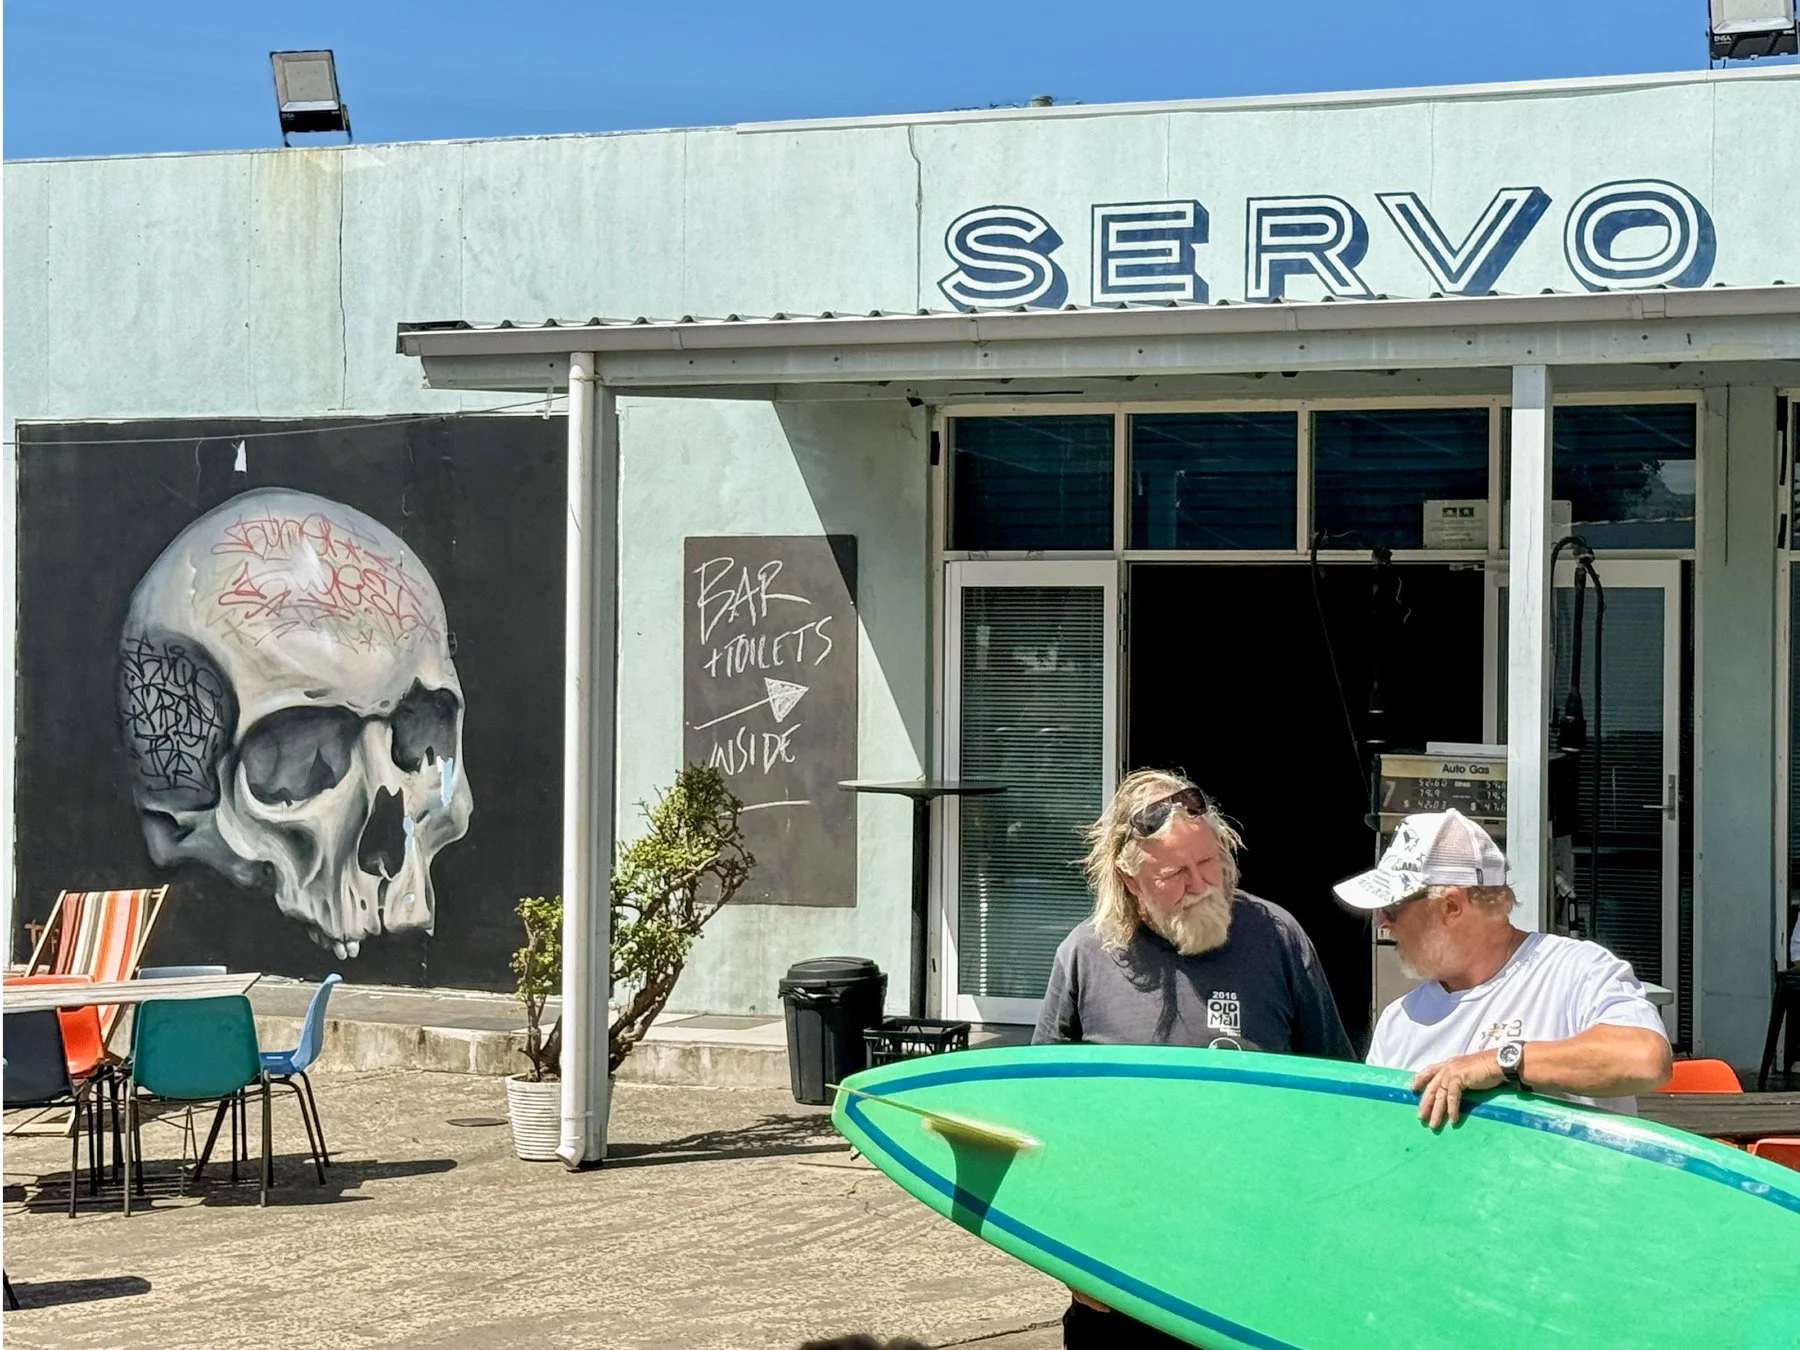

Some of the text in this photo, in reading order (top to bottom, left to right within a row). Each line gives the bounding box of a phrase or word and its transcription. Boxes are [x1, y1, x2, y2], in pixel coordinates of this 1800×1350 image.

[937, 178, 1716, 312] SERVO
[693, 557, 811, 645] BAR
[709, 723, 801, 775] INSIDE
[1442, 764, 1490, 775] Auto Gas
[1382, 780, 1396, 808] 7
